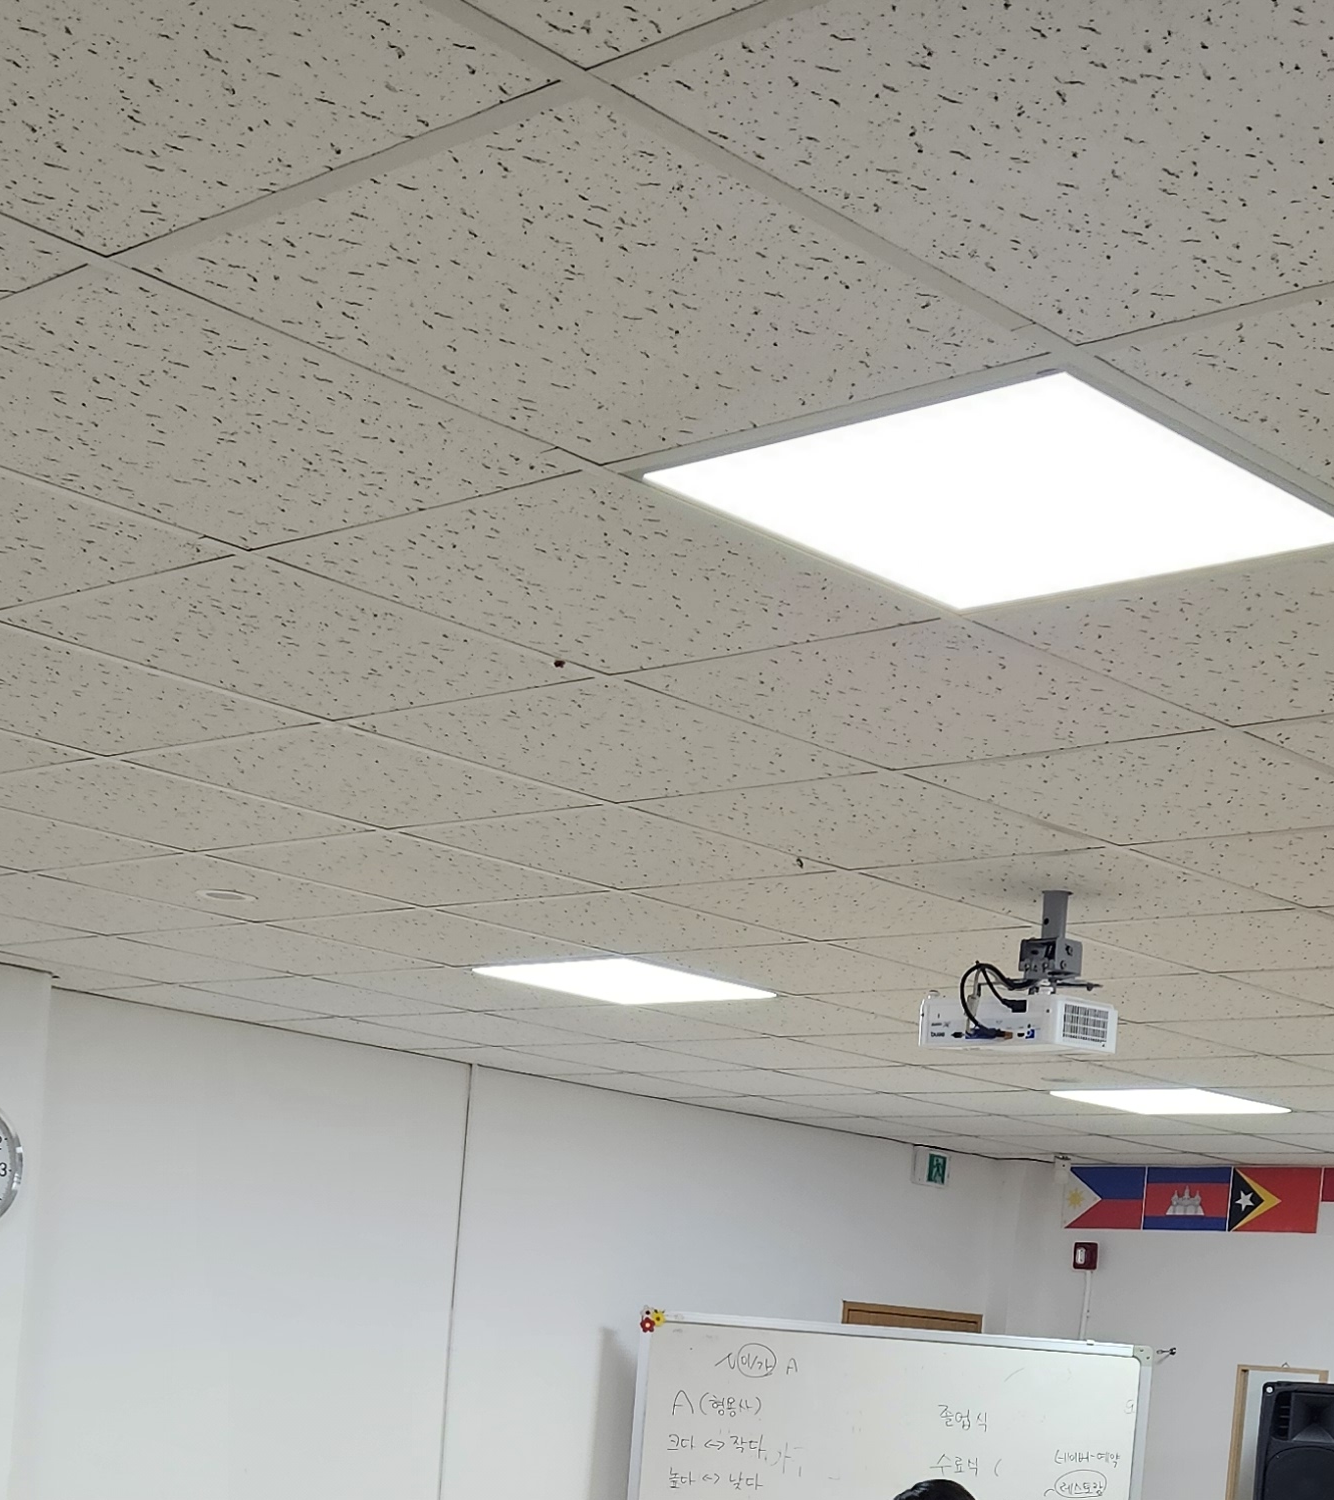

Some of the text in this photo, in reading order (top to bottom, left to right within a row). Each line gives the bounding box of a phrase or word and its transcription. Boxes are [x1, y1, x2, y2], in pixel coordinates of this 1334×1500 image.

[786, 1357, 798, 1375] A
[667, 1433, 767, 1459] 크다 작다
